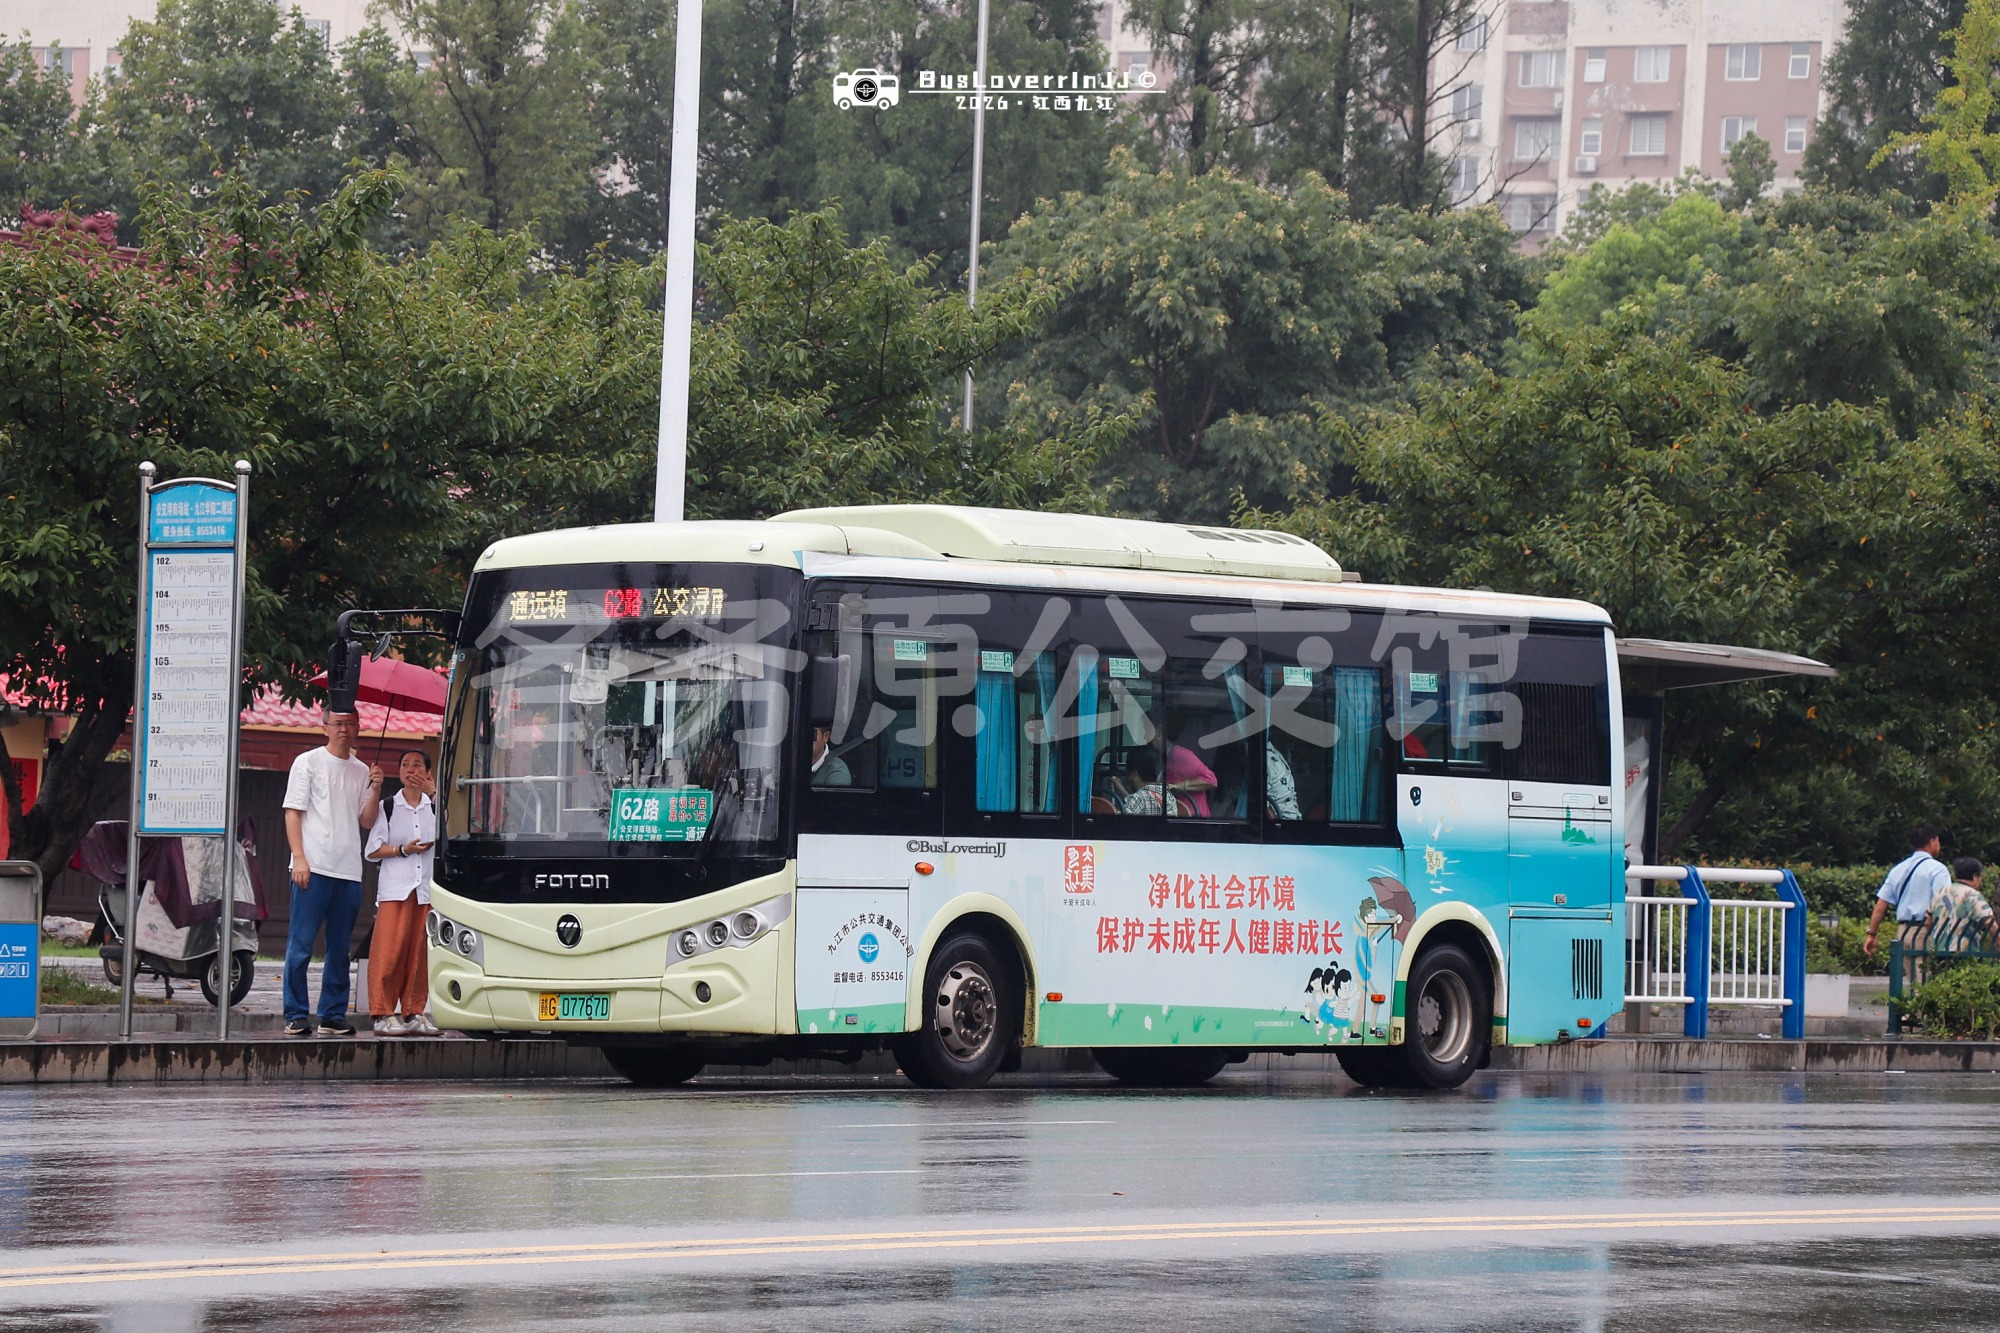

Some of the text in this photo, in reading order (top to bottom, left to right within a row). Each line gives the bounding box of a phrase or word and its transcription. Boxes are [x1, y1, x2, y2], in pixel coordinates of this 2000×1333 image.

[156, 557, 169, 565] 102
[155, 591, 169, 599] 104
[510, 590, 568, 621] 通远镇
[156, 624, 170, 632] 105
[152, 693, 162, 701] 35
[151, 726, 161, 734] 32
[149, 760, 158, 768] 72
[621, 798, 659, 821] 62路
[535, 874, 609, 888] FOTON
[1148, 873, 1296, 911] 净化社会环境
[827, 912, 914, 957] 九江市公共交通集团公司
[1096, 917, 1343, 955] 保护未成年人健康成长
